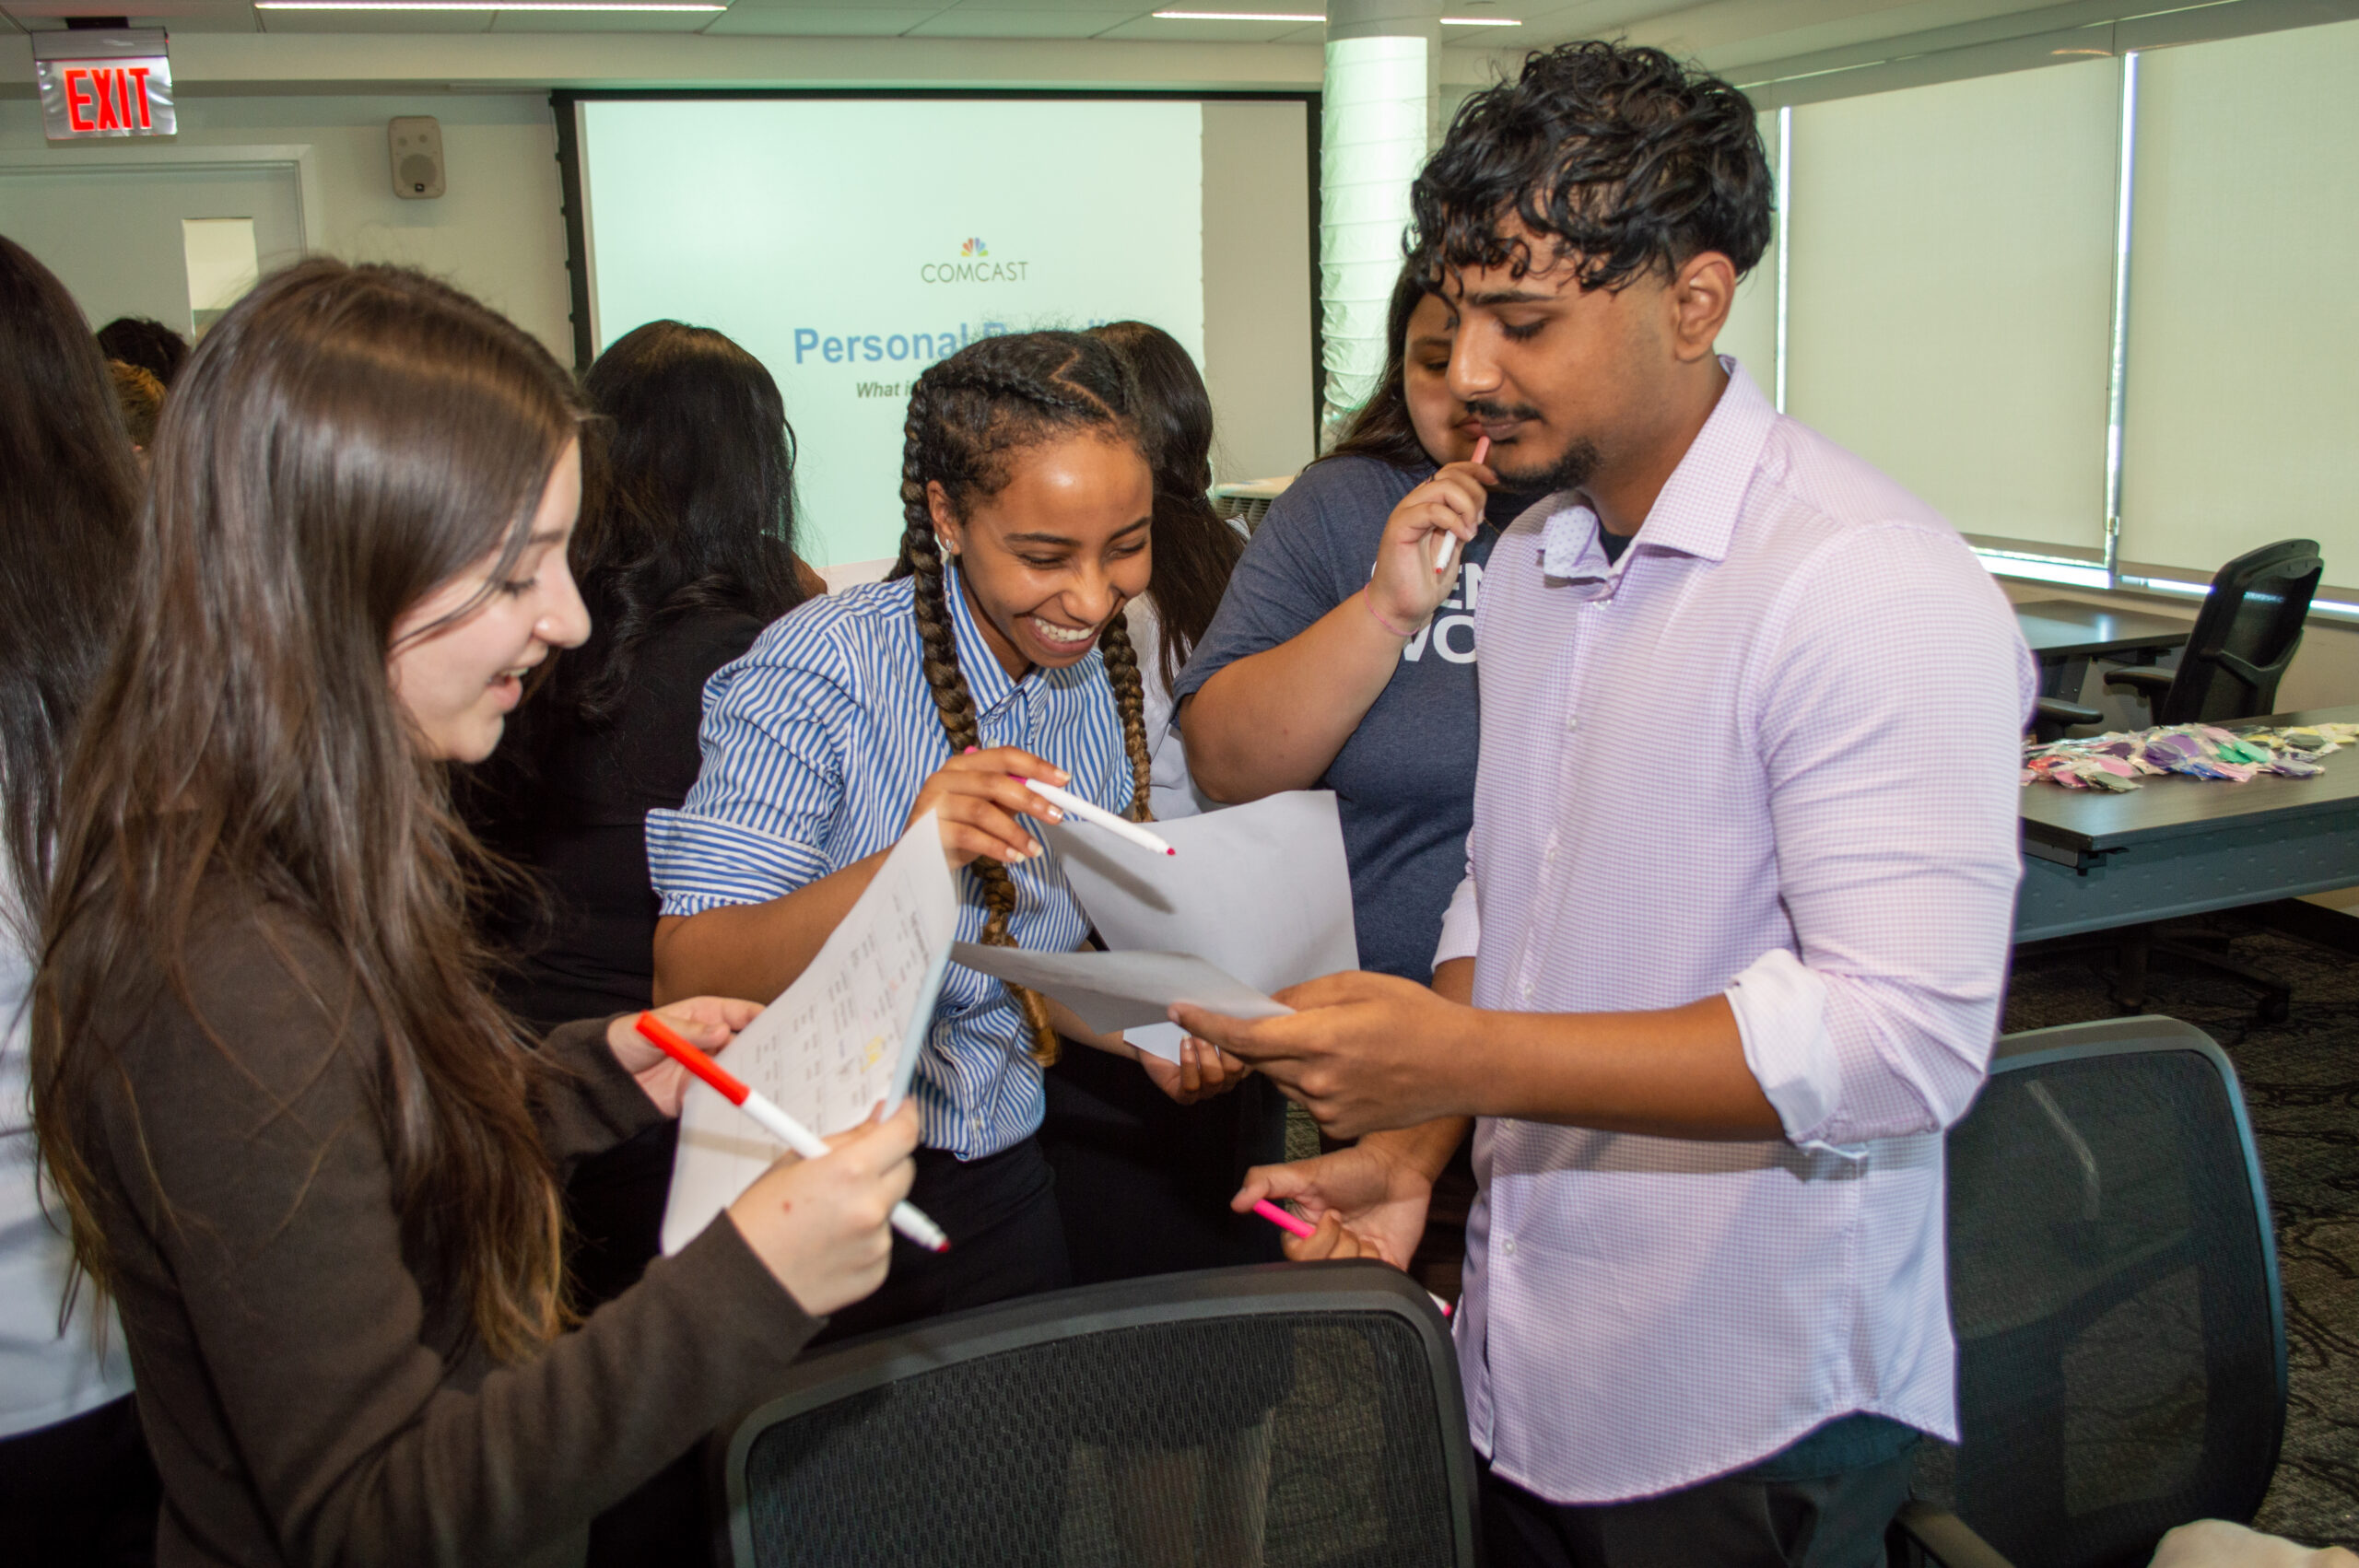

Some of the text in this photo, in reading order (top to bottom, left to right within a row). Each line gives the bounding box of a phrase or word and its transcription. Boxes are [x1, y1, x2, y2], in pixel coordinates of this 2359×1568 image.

[64, 67, 151, 132] EXIT
[921, 262, 1028, 283] COMCAST
[794, 323, 968, 364] Personal
[857, 381, 899, 398] What
